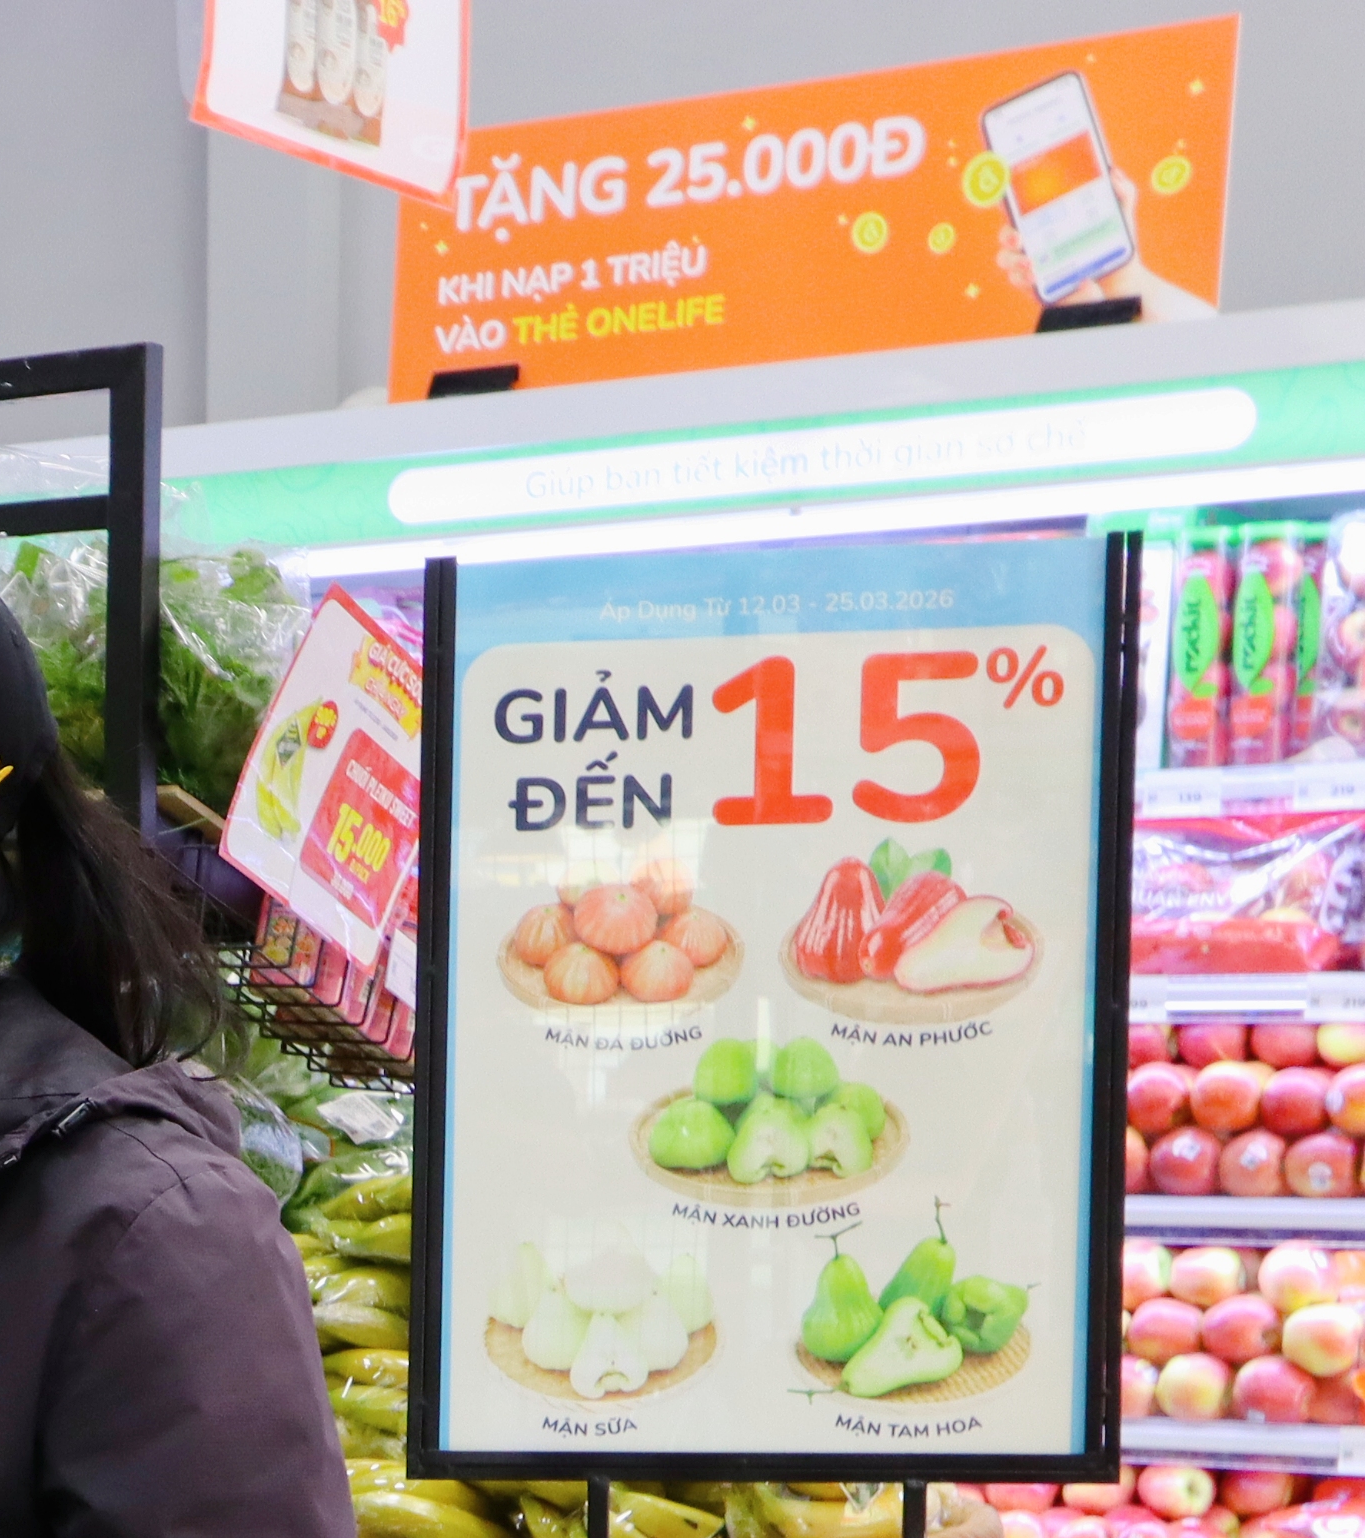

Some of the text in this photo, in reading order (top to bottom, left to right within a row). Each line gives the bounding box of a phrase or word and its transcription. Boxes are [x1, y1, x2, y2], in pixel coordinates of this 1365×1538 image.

[455, 116, 924, 241] TẶNG 25.000Đ
[437, 241, 706, 304] KHI NẠP 1 TRIỆU
[435, 294, 725, 353] VÀO THẺ ONELIFE
[636, 597, 696, 623] Dụng
[739, 594, 800, 616] 12.03
[825, 589, 954, 613] 25.03.2026
[494, 669, 694, 745] GIẢM
[508, 751, 672, 831] ĐẾN
[327, 803, 392, 873] 15.000
[830, 1019, 993, 1047] MẬN AN PHƯỚC
[671, 1202, 862, 1229] MẬN XANH ĐƯỜNG
[542, 1416, 589, 1438] MẬN
[835, 1414, 983, 1439] MẬN TAM HOA
